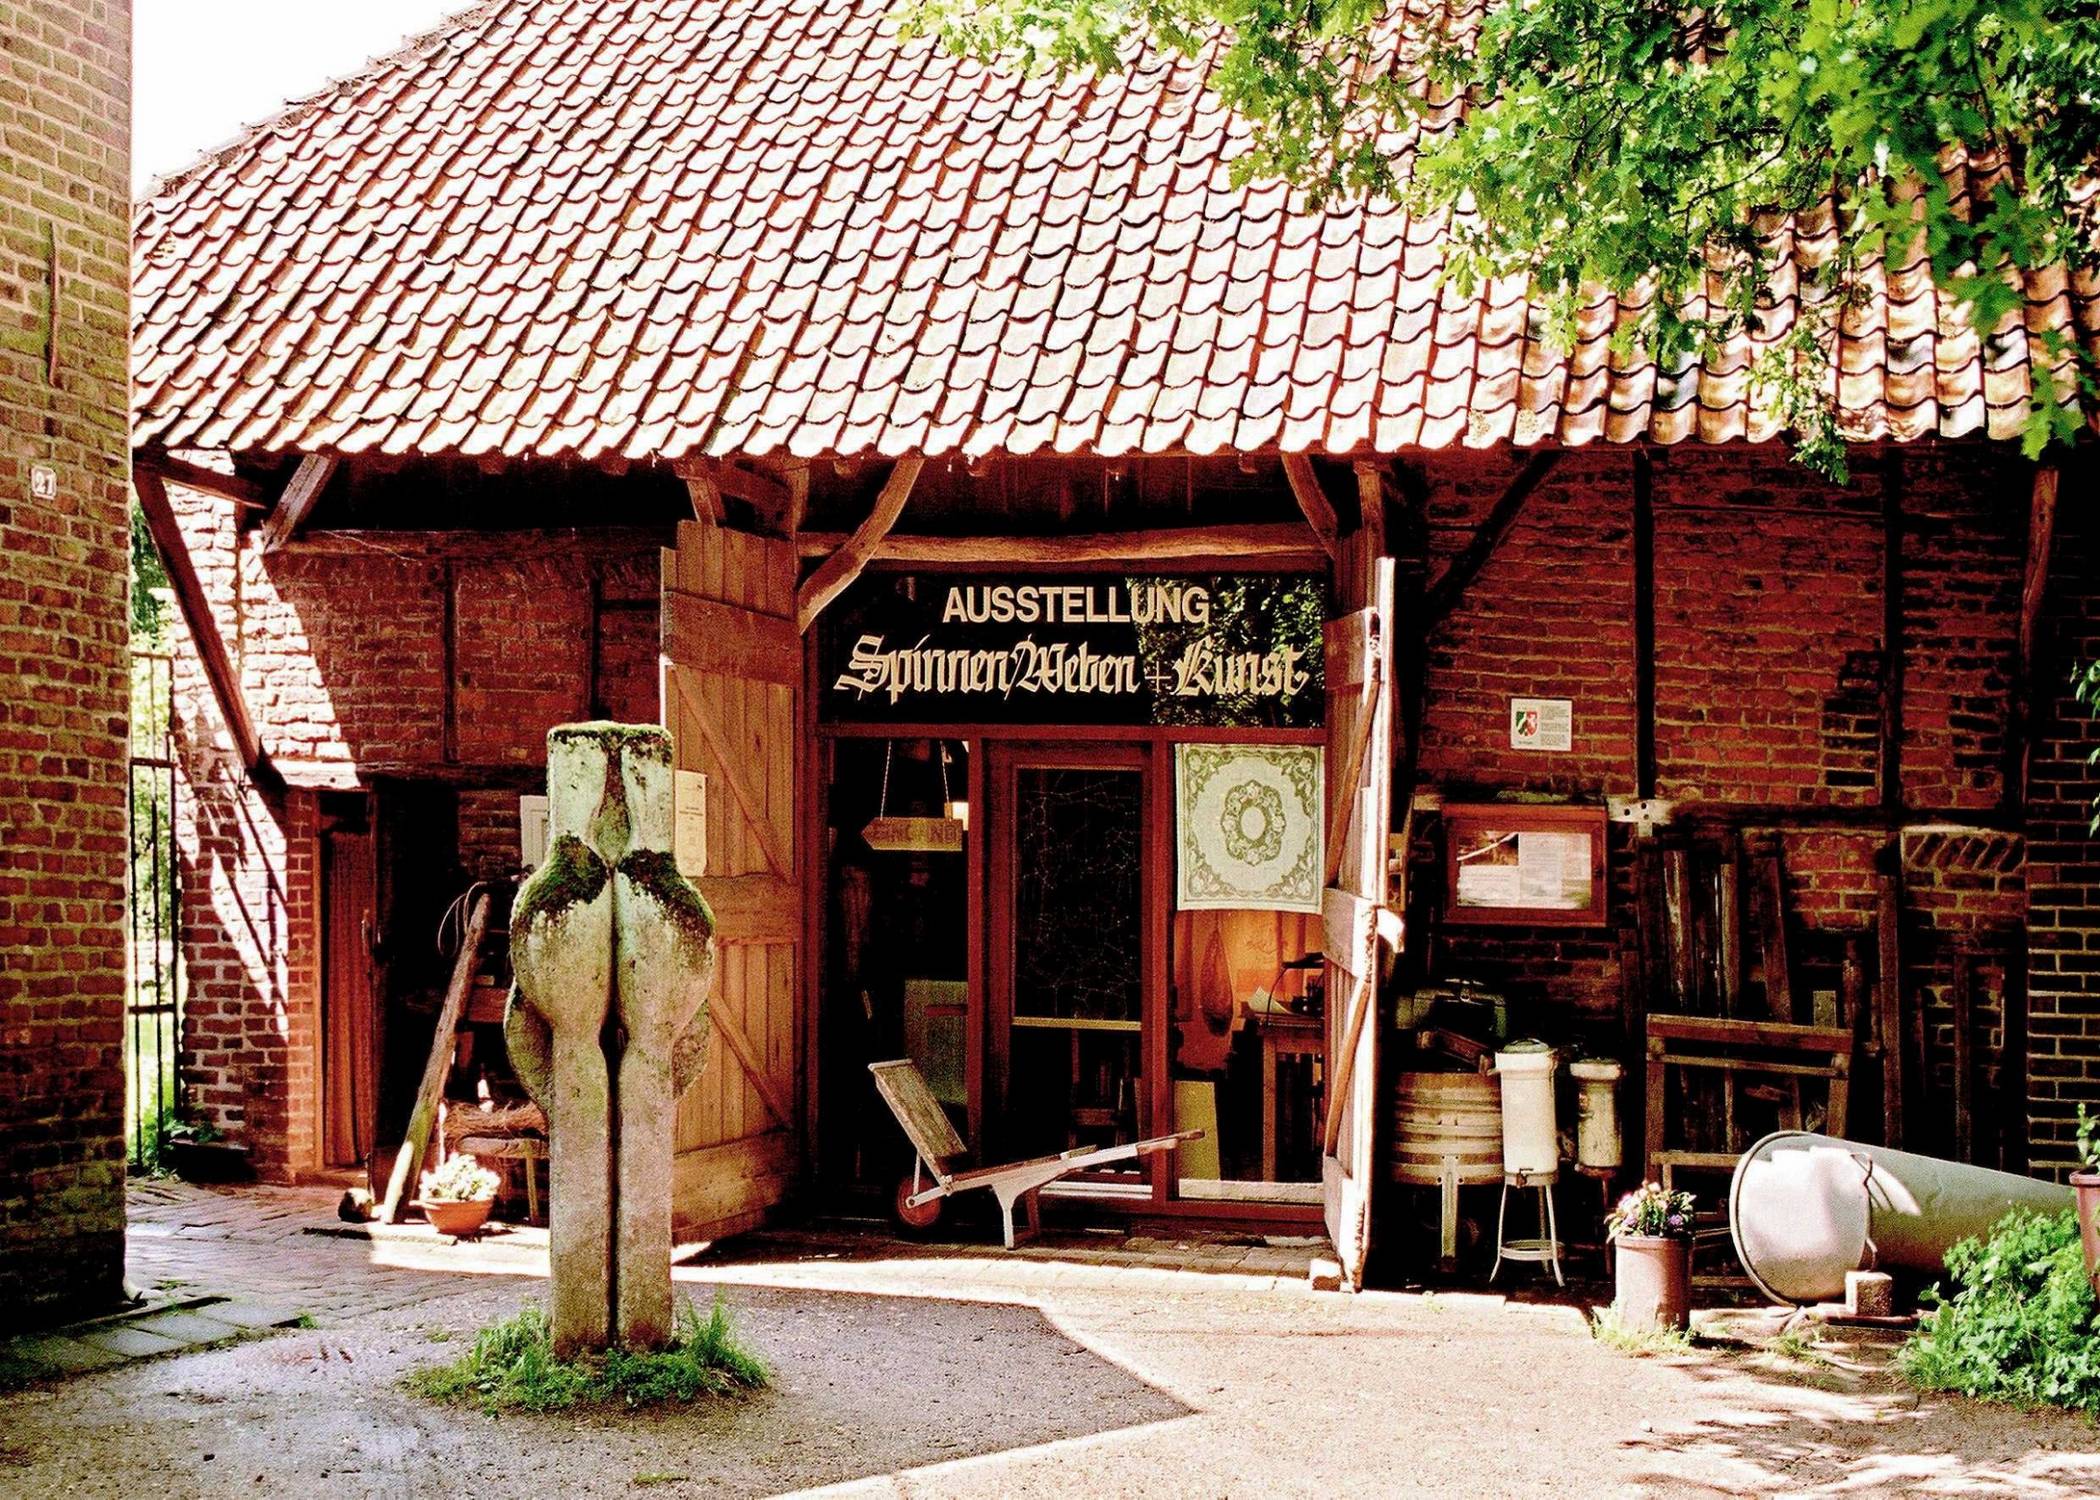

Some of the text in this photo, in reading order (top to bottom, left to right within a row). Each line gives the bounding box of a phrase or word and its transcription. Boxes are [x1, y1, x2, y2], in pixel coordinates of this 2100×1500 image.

[35, 470, 54, 494] 21
[942, 585, 1209, 623] AUSSTELLUNG
[1144, 660, 1172, 693] +
[1170, 635, 1310, 696] Kunst
